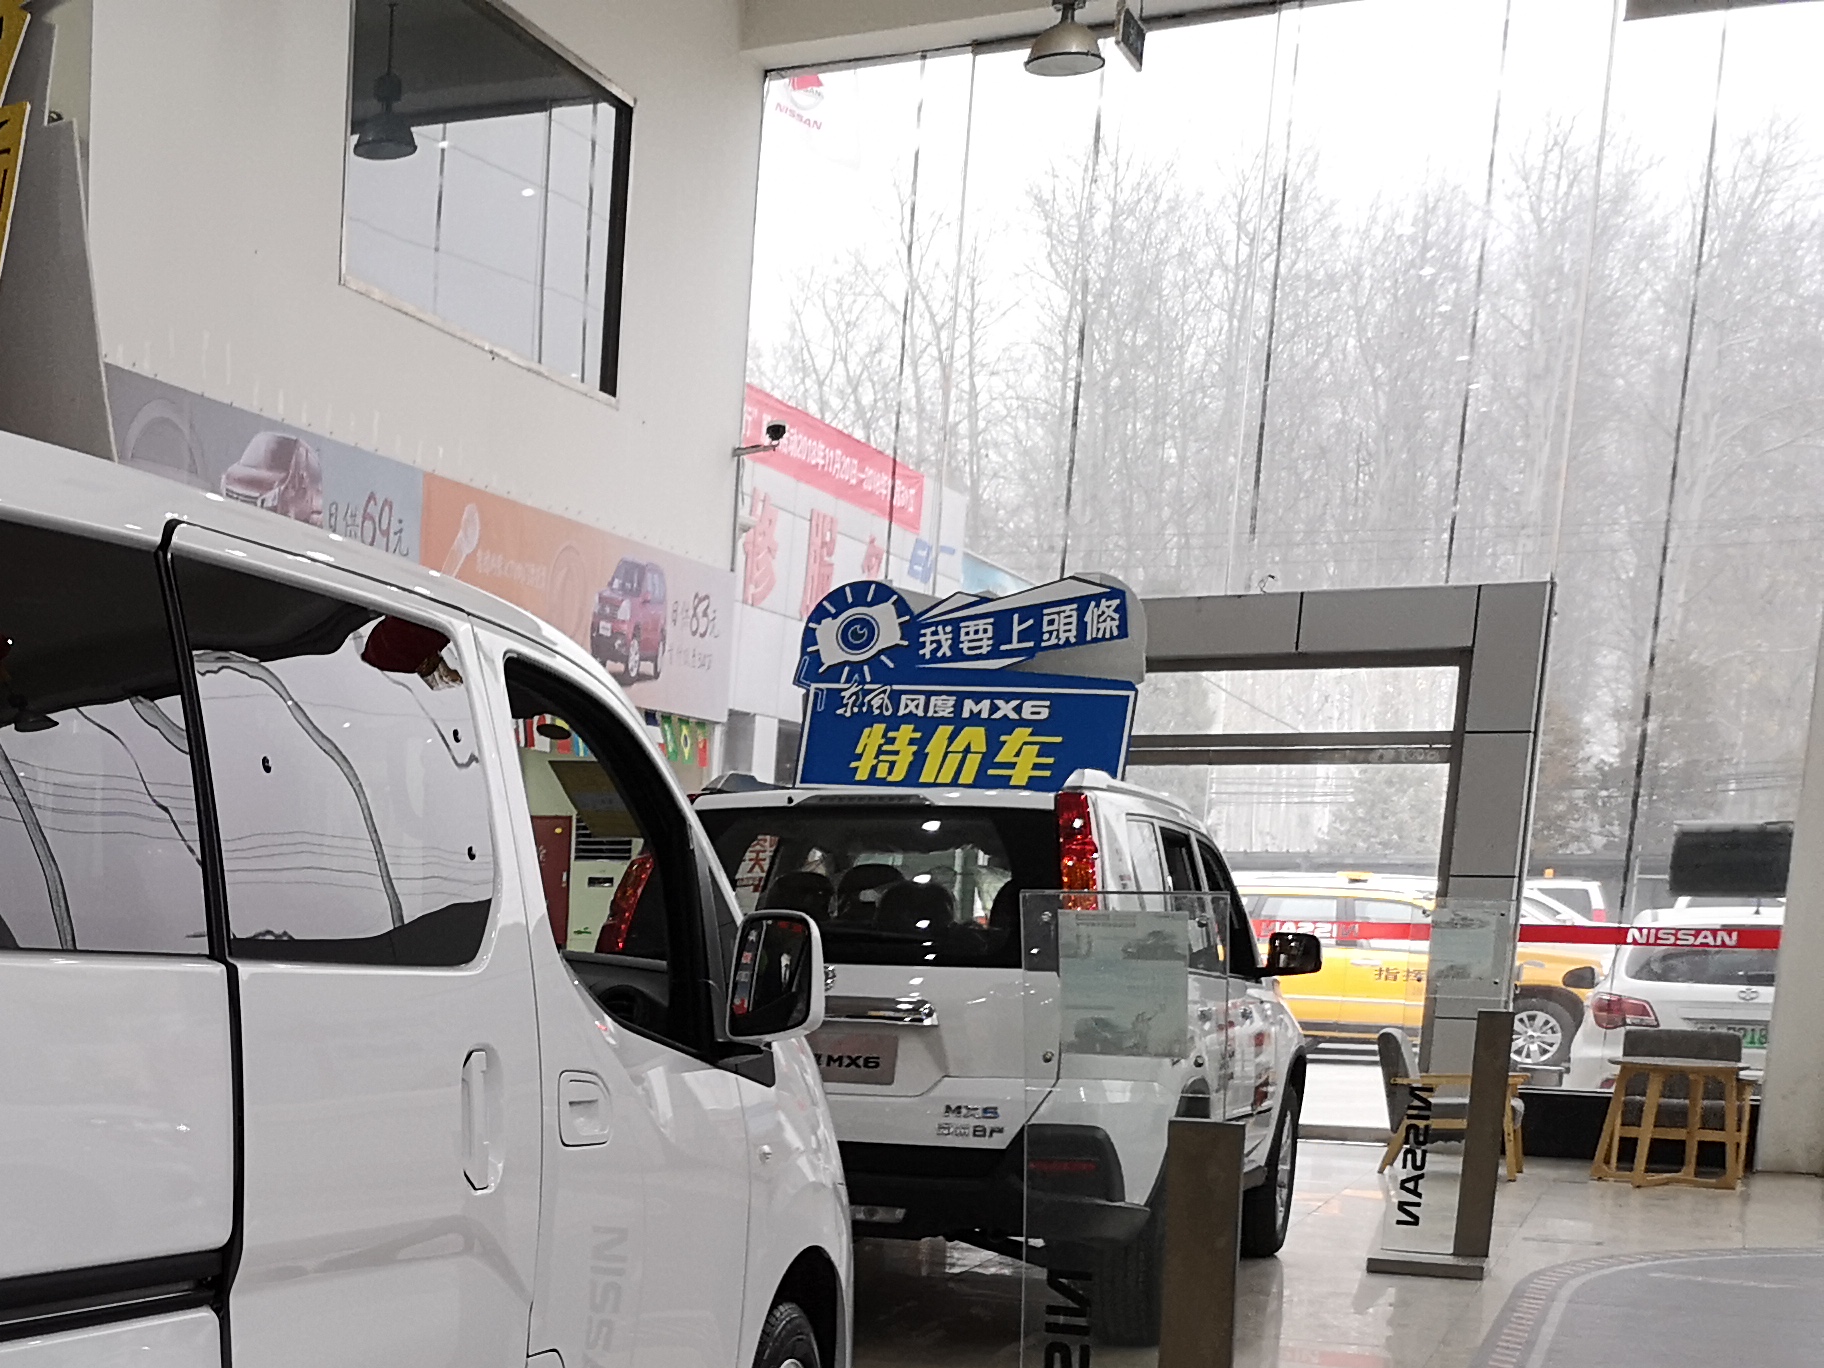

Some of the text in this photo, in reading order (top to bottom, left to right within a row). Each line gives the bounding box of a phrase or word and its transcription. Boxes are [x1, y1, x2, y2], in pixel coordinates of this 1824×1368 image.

[775, 102, 824, 131] NISSAN
[919, 598, 1121, 660] 我要上頭條
[897, 694, 956, 717] 风度
[961, 698, 1051, 720] MX6
[849, 723, 1063, 786] 特价车
[1626, 928, 1738, 946] NISSAN
[826, 1055, 881, 1069] MX6
[943, 1104, 1000, 1120] MX6
